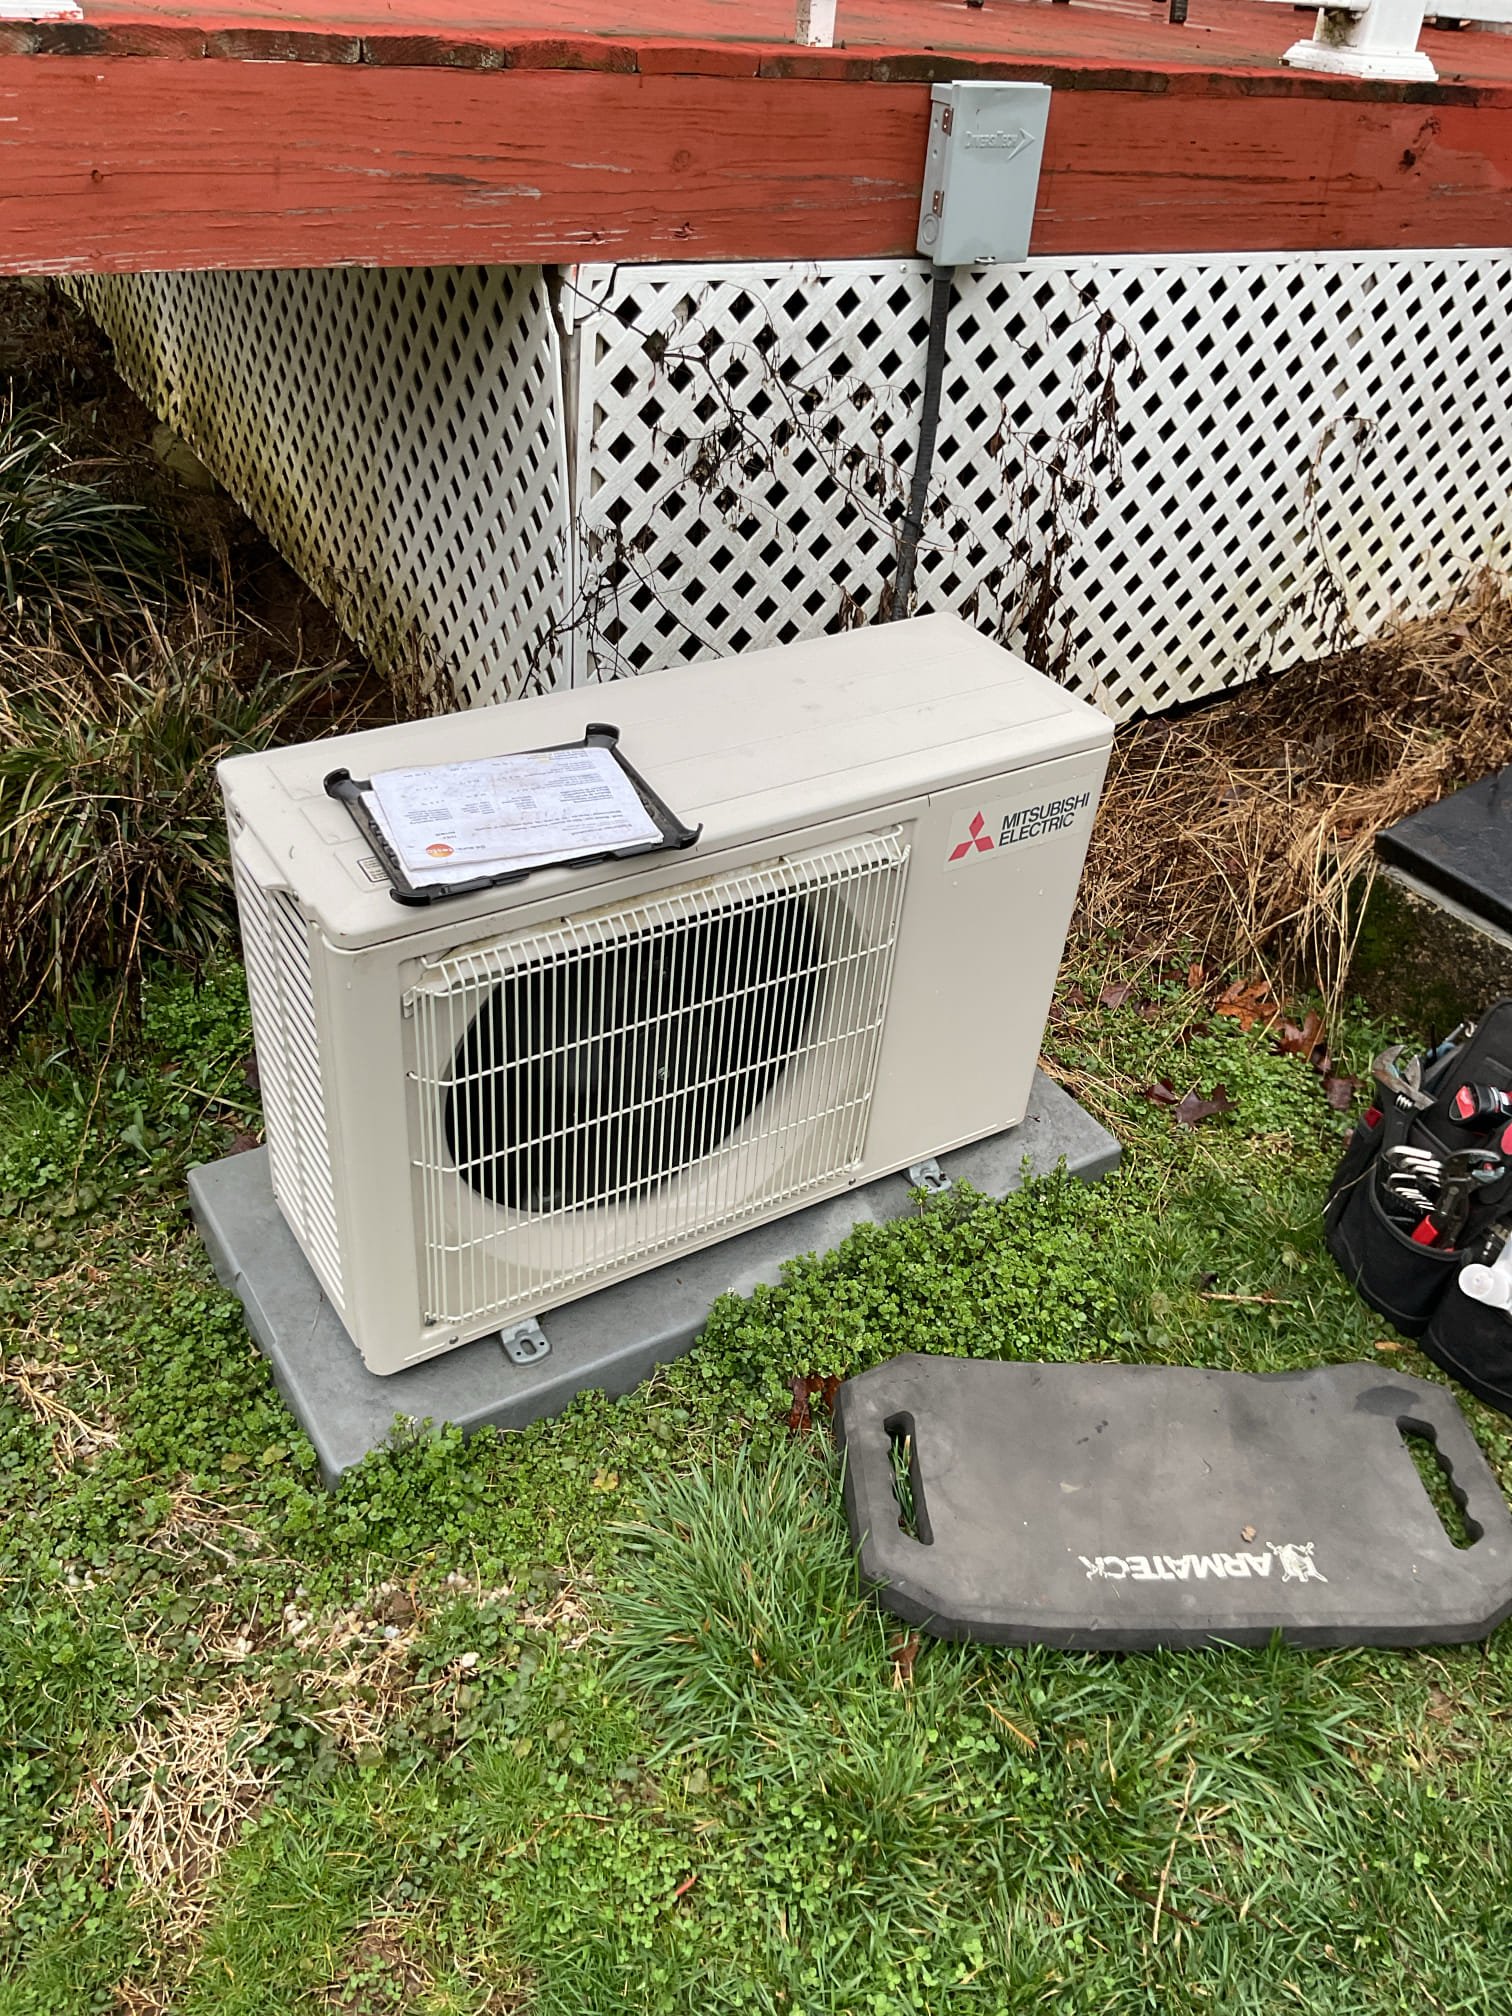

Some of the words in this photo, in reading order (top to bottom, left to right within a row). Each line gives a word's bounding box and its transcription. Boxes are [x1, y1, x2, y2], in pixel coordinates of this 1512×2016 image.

[1001, 791, 1091, 830] MITSUBISHI
[998, 812, 1075, 847] ELECTRIC
[1077, 1551, 1272, 1581] ARMATECK
